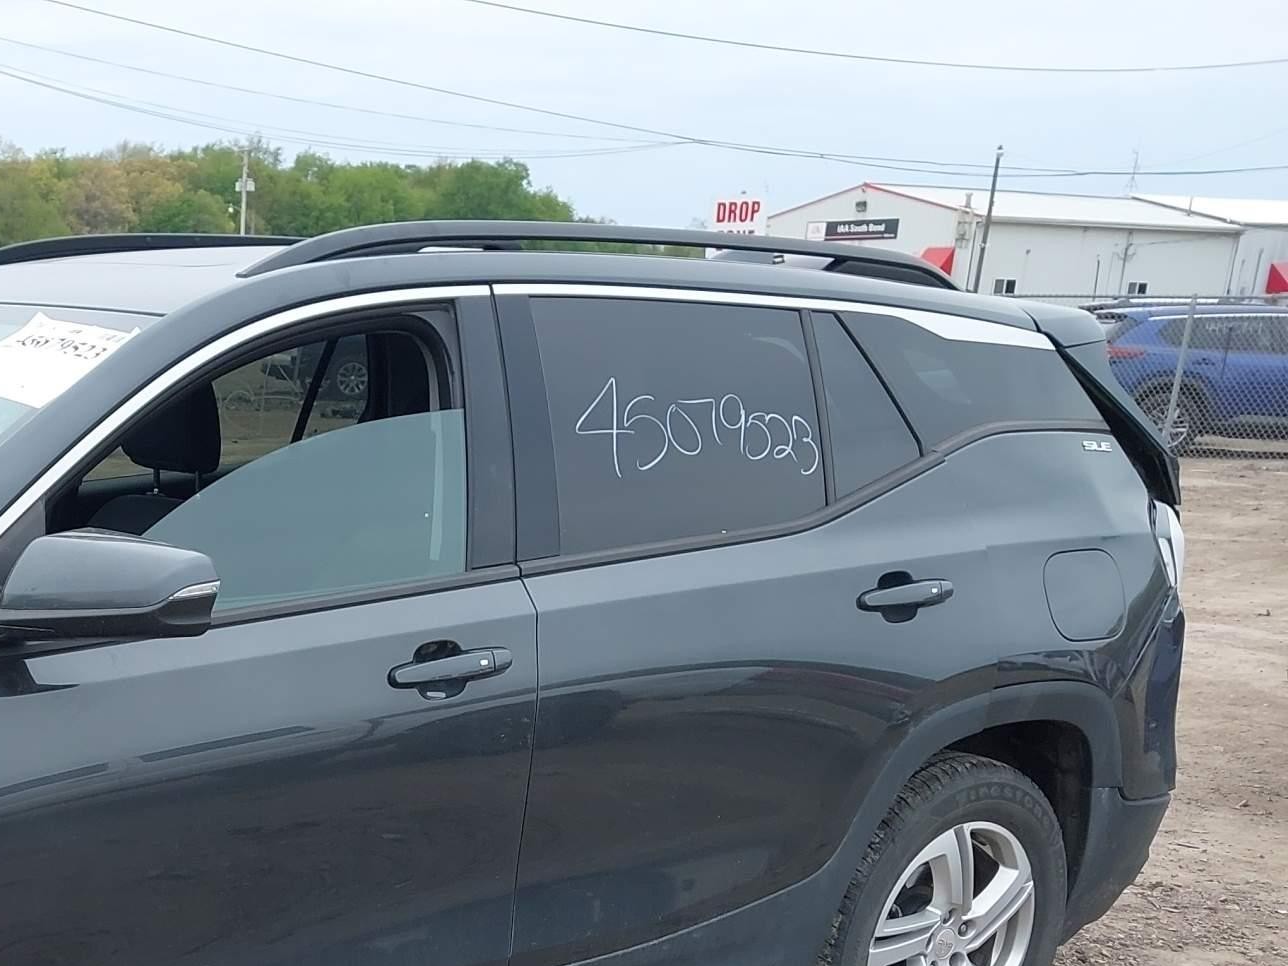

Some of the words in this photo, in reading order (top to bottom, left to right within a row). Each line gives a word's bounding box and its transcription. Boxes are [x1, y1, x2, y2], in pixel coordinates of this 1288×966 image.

[716, 201, 761, 223] DROP
[575, 377, 819, 478] 45079523
[1082, 440, 1112, 451] SLE
